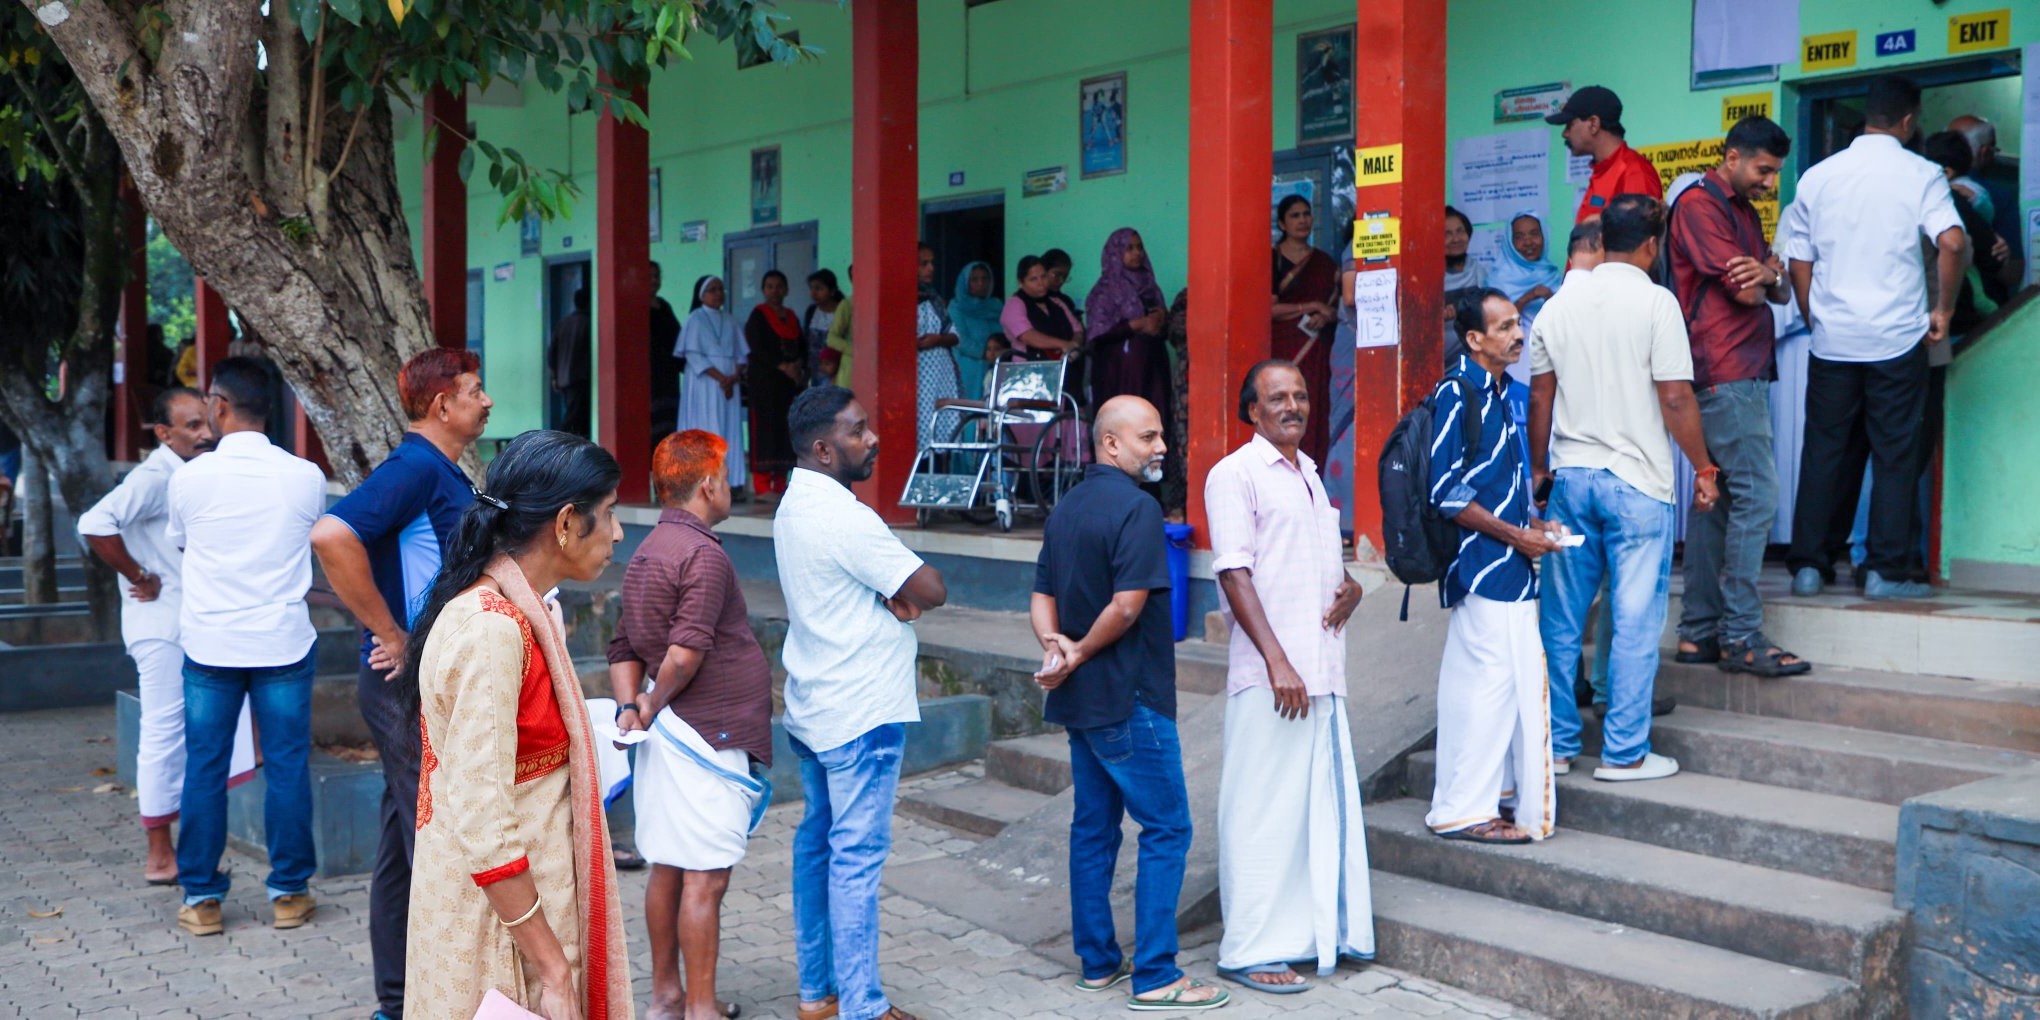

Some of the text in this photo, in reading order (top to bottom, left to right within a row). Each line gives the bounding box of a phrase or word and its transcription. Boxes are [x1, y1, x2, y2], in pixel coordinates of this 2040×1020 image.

[1959, 20, 1998, 44] EXIT
[1807, 41, 1850, 63] ENTRY
[1883, 35, 1907, 51] 4A
[1726, 103, 1766, 121] FEMALE
[1363, 155, 1394, 175] MALE
